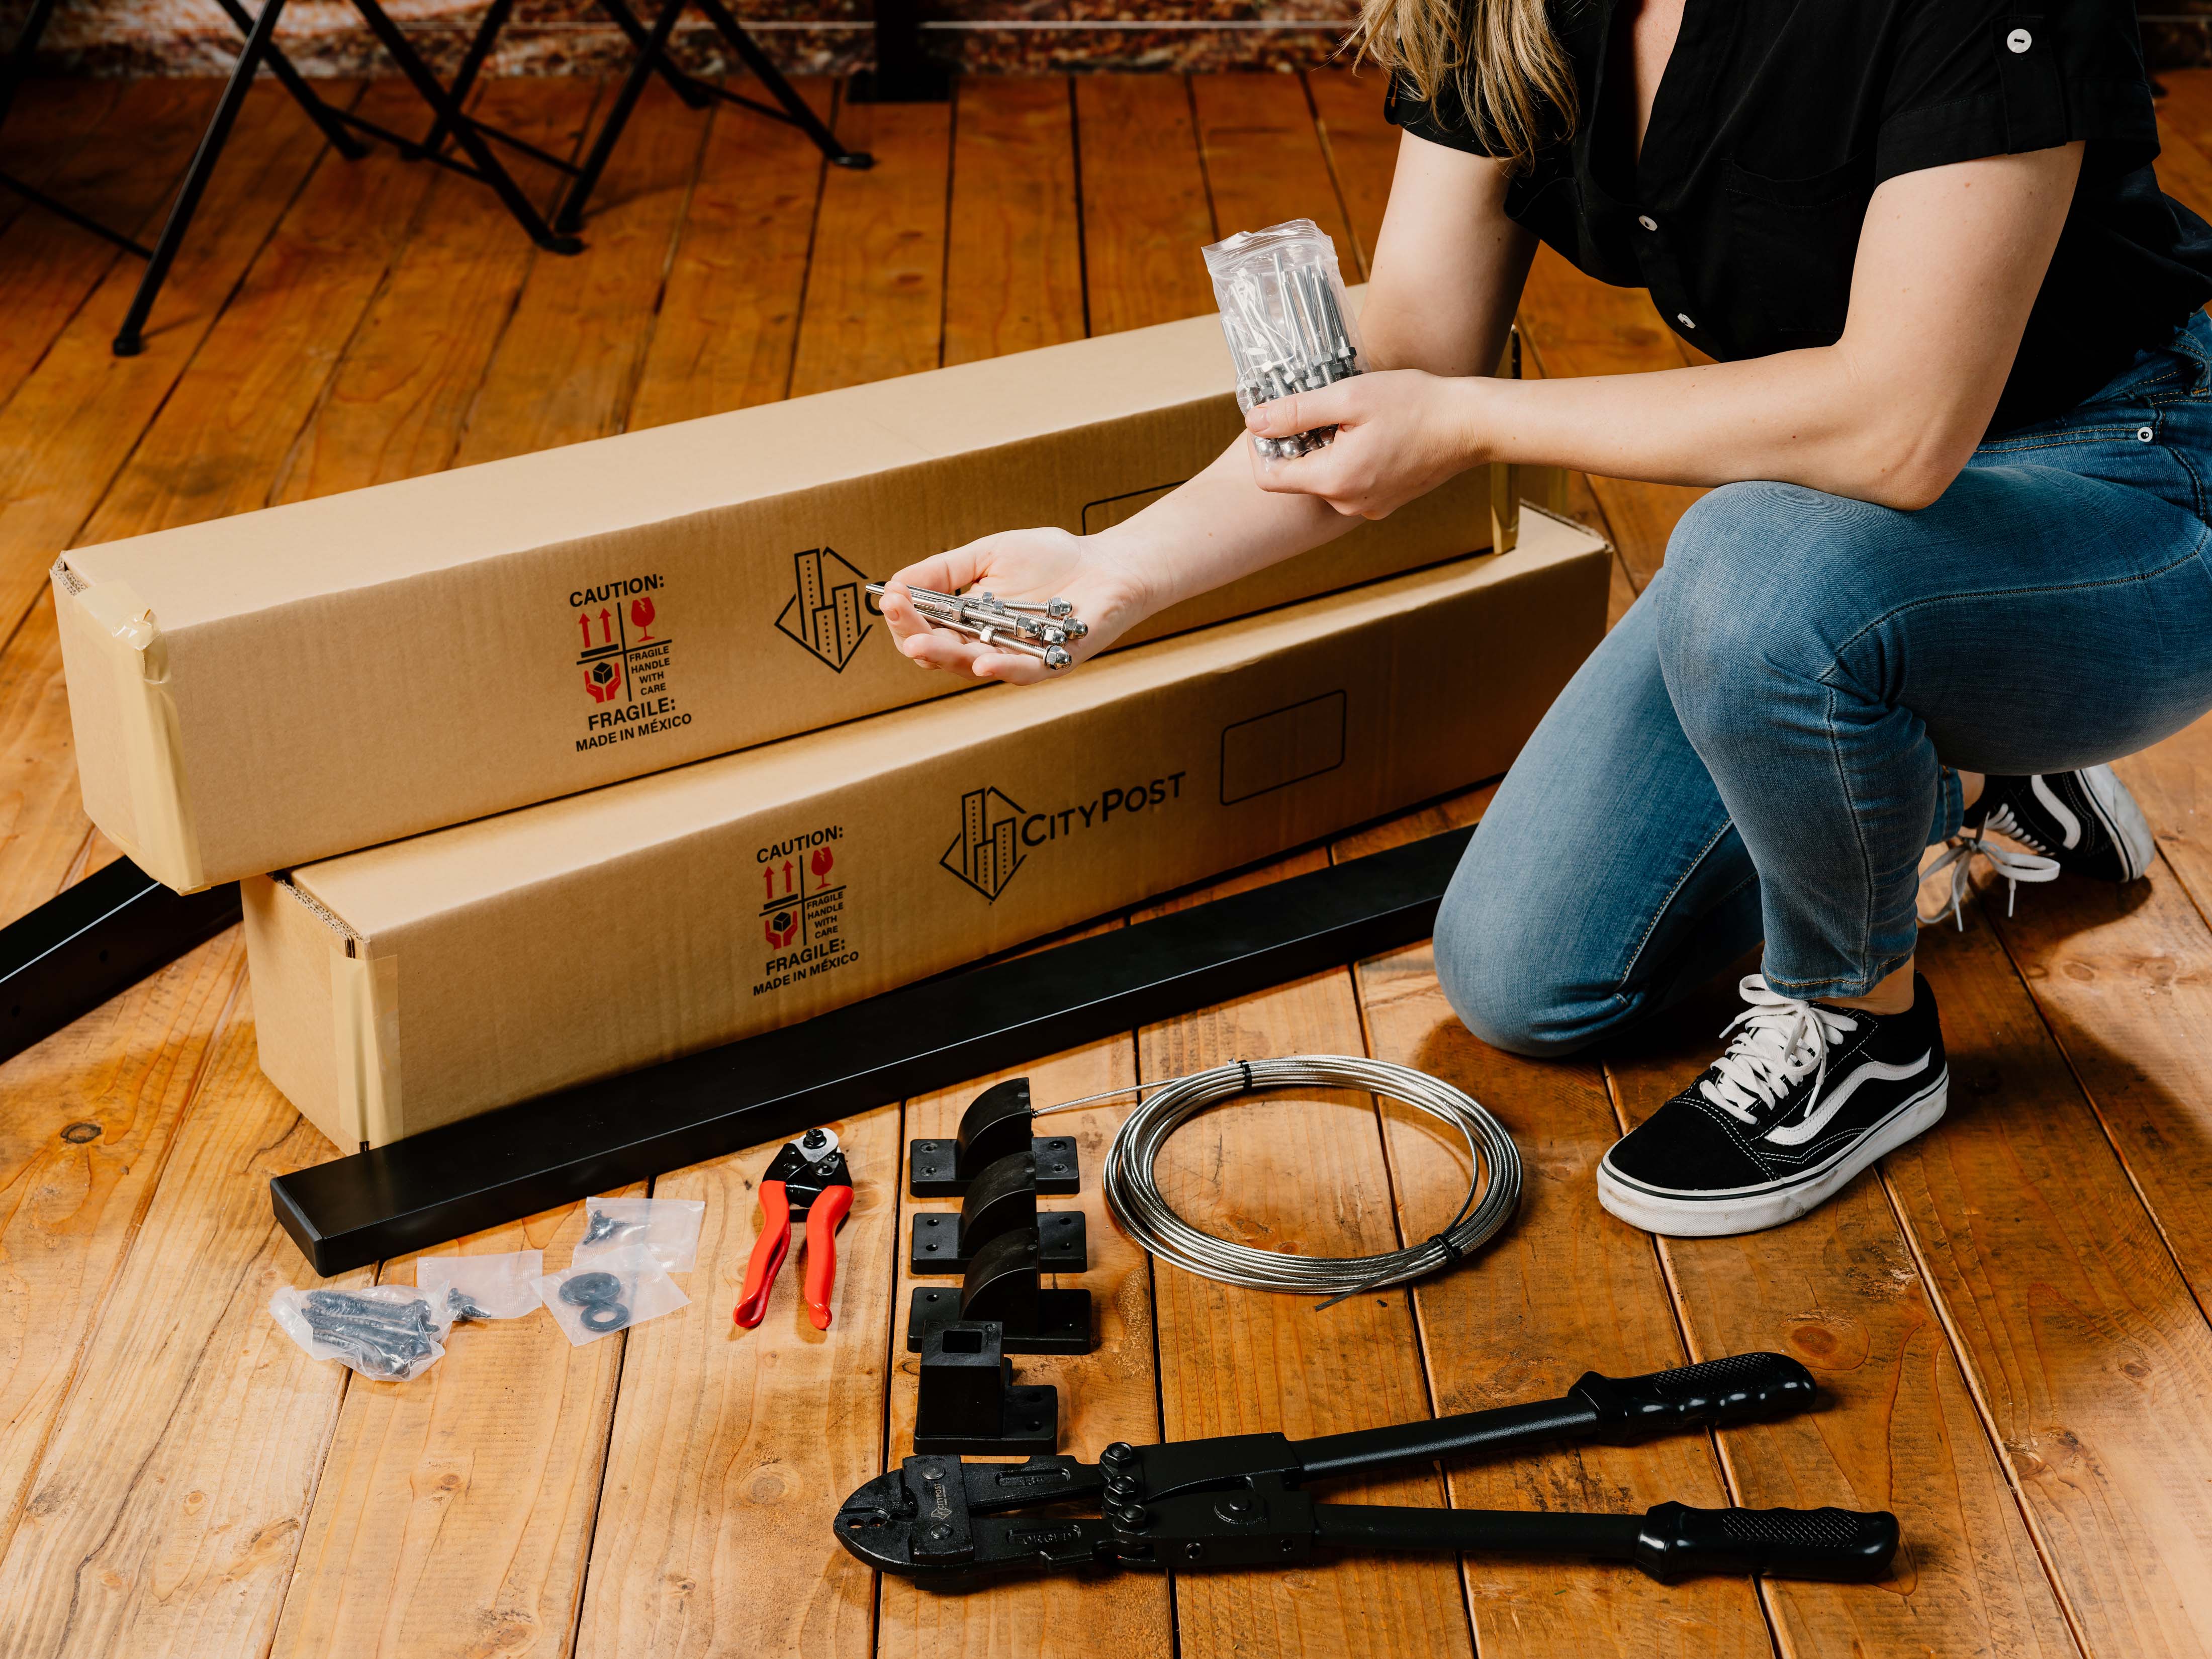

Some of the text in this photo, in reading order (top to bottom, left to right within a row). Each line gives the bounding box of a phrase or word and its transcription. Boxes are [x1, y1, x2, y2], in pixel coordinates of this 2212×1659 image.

[569, 573, 664, 608] CAUTION:
[629, 646, 670, 663] FRAGILE
[631, 657, 670, 674] HANDLE
[639, 671, 664, 684] WITH
[640, 682, 666, 696] CARE
[588, 697, 676, 731] FRAGILE:
[576, 713, 692, 752] MADE IN MÉXICO
[757, 825, 843, 863] CAUTION:
[806, 891, 844, 910] FRAGILE
[807, 902, 844, 920] HANDLE
[814, 915, 837, 929] WITH
[814, 925, 838, 939] CARE
[766, 938, 845, 976] FRAGILE:
[753, 951, 859, 996] MADE IN MÉXICO
[934, 1483, 945, 1509] CITYPOST
